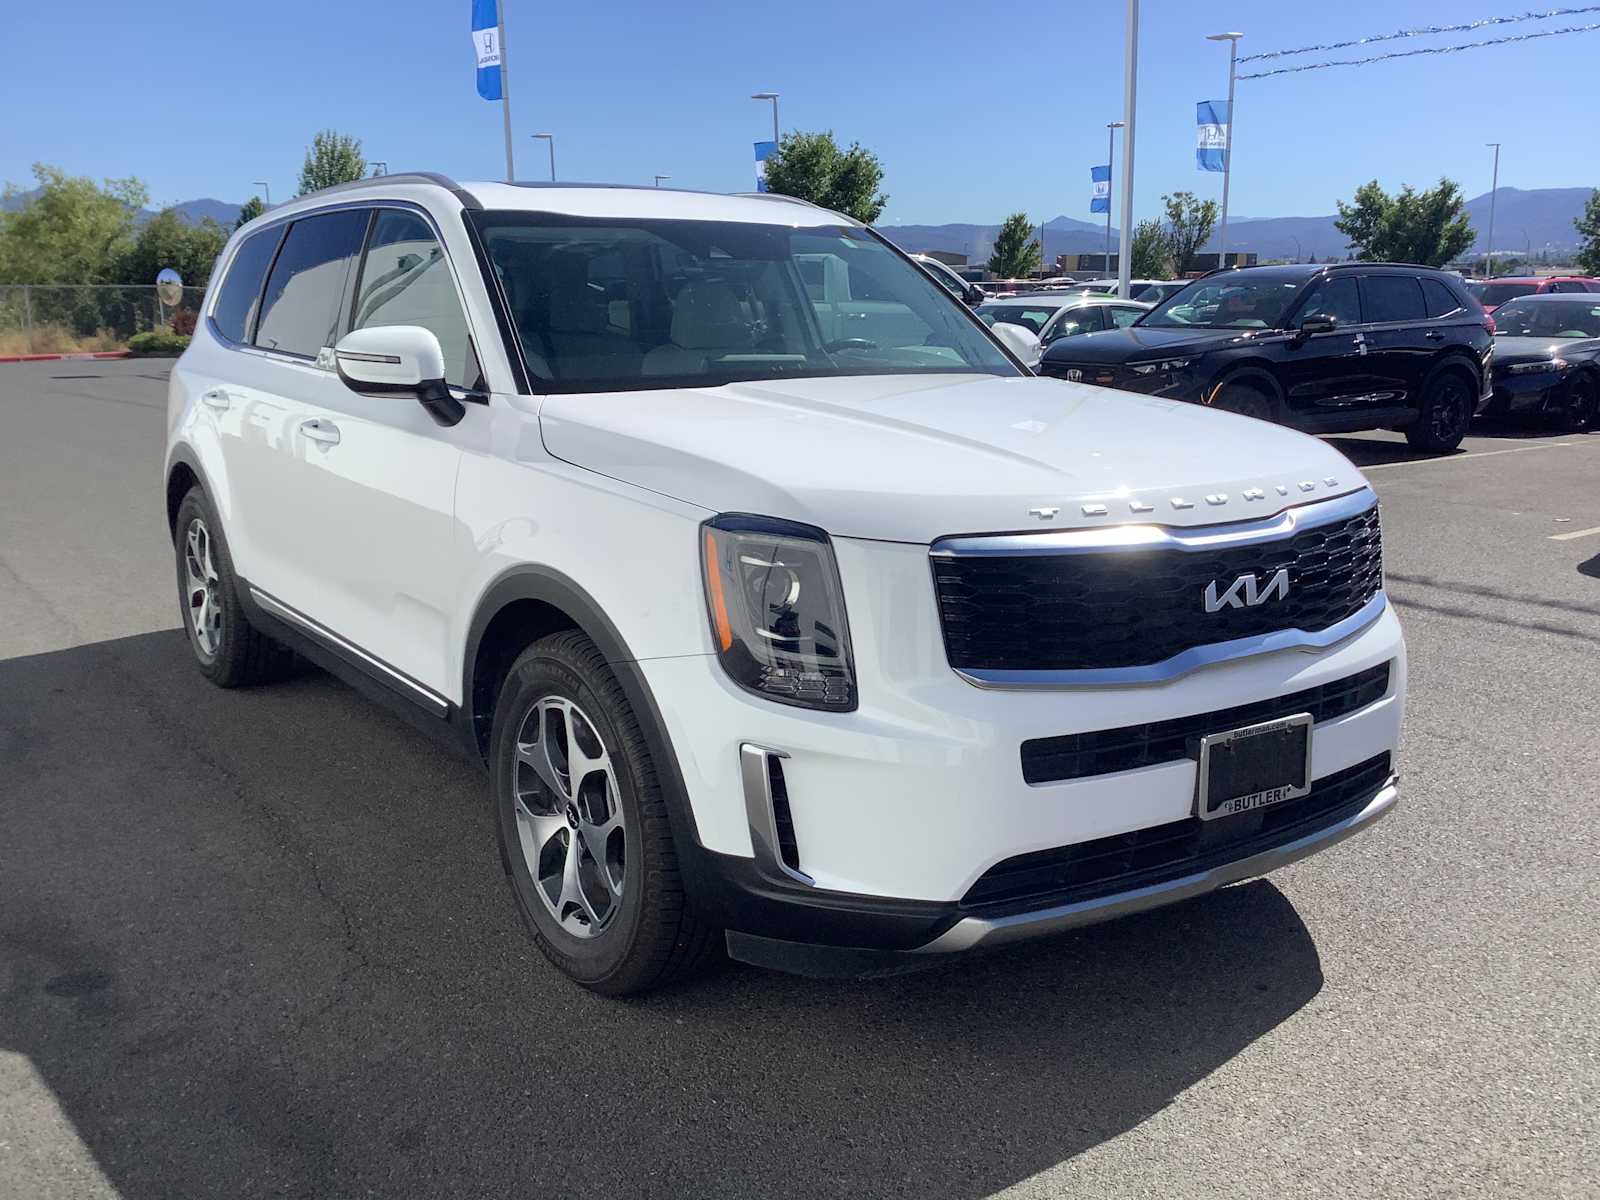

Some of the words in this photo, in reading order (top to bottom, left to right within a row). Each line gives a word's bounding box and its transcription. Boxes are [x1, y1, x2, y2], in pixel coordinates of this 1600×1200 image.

[1028, 476, 1339, 520] TELLURIDE
[1204, 568, 1289, 613] KIA
[1233, 789, 1281, 811] BUTLER
